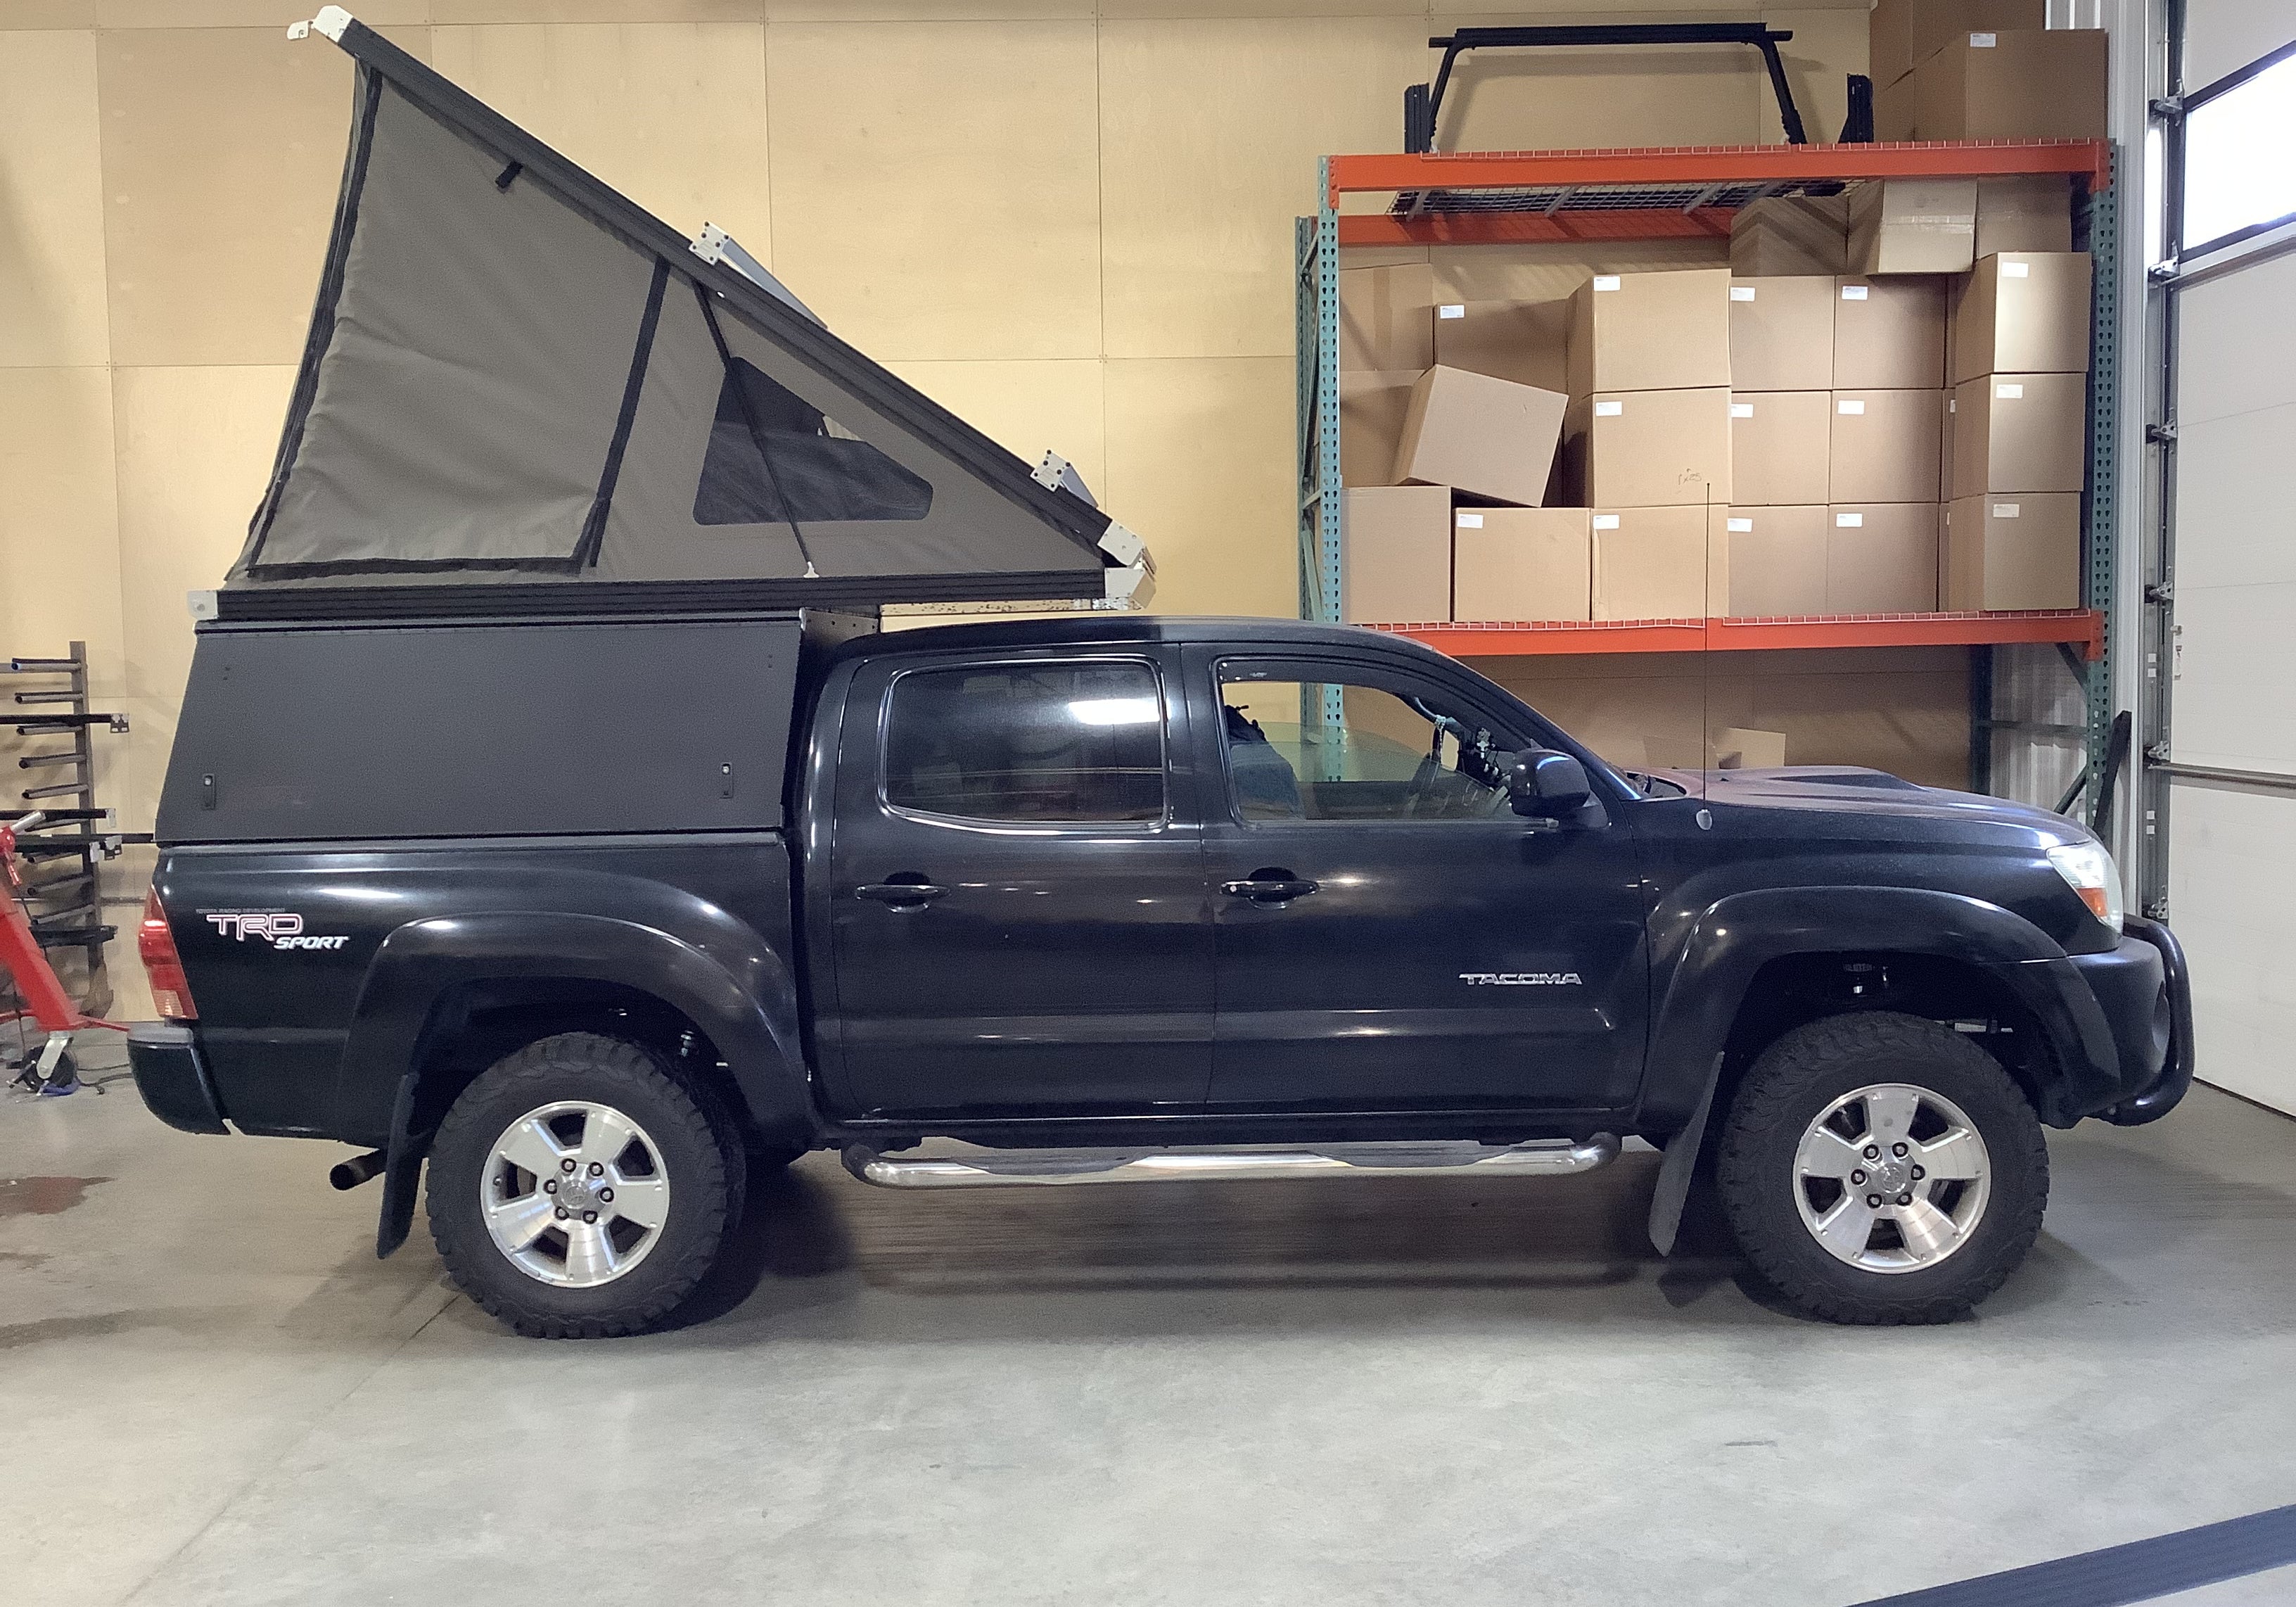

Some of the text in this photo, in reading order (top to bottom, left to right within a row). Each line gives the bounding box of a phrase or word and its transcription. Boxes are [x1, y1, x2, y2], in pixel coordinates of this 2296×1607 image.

[205, 913, 304, 941] TRD
[274, 936, 350, 950] SPORT
[1458, 972, 1583, 985] TACOMA
